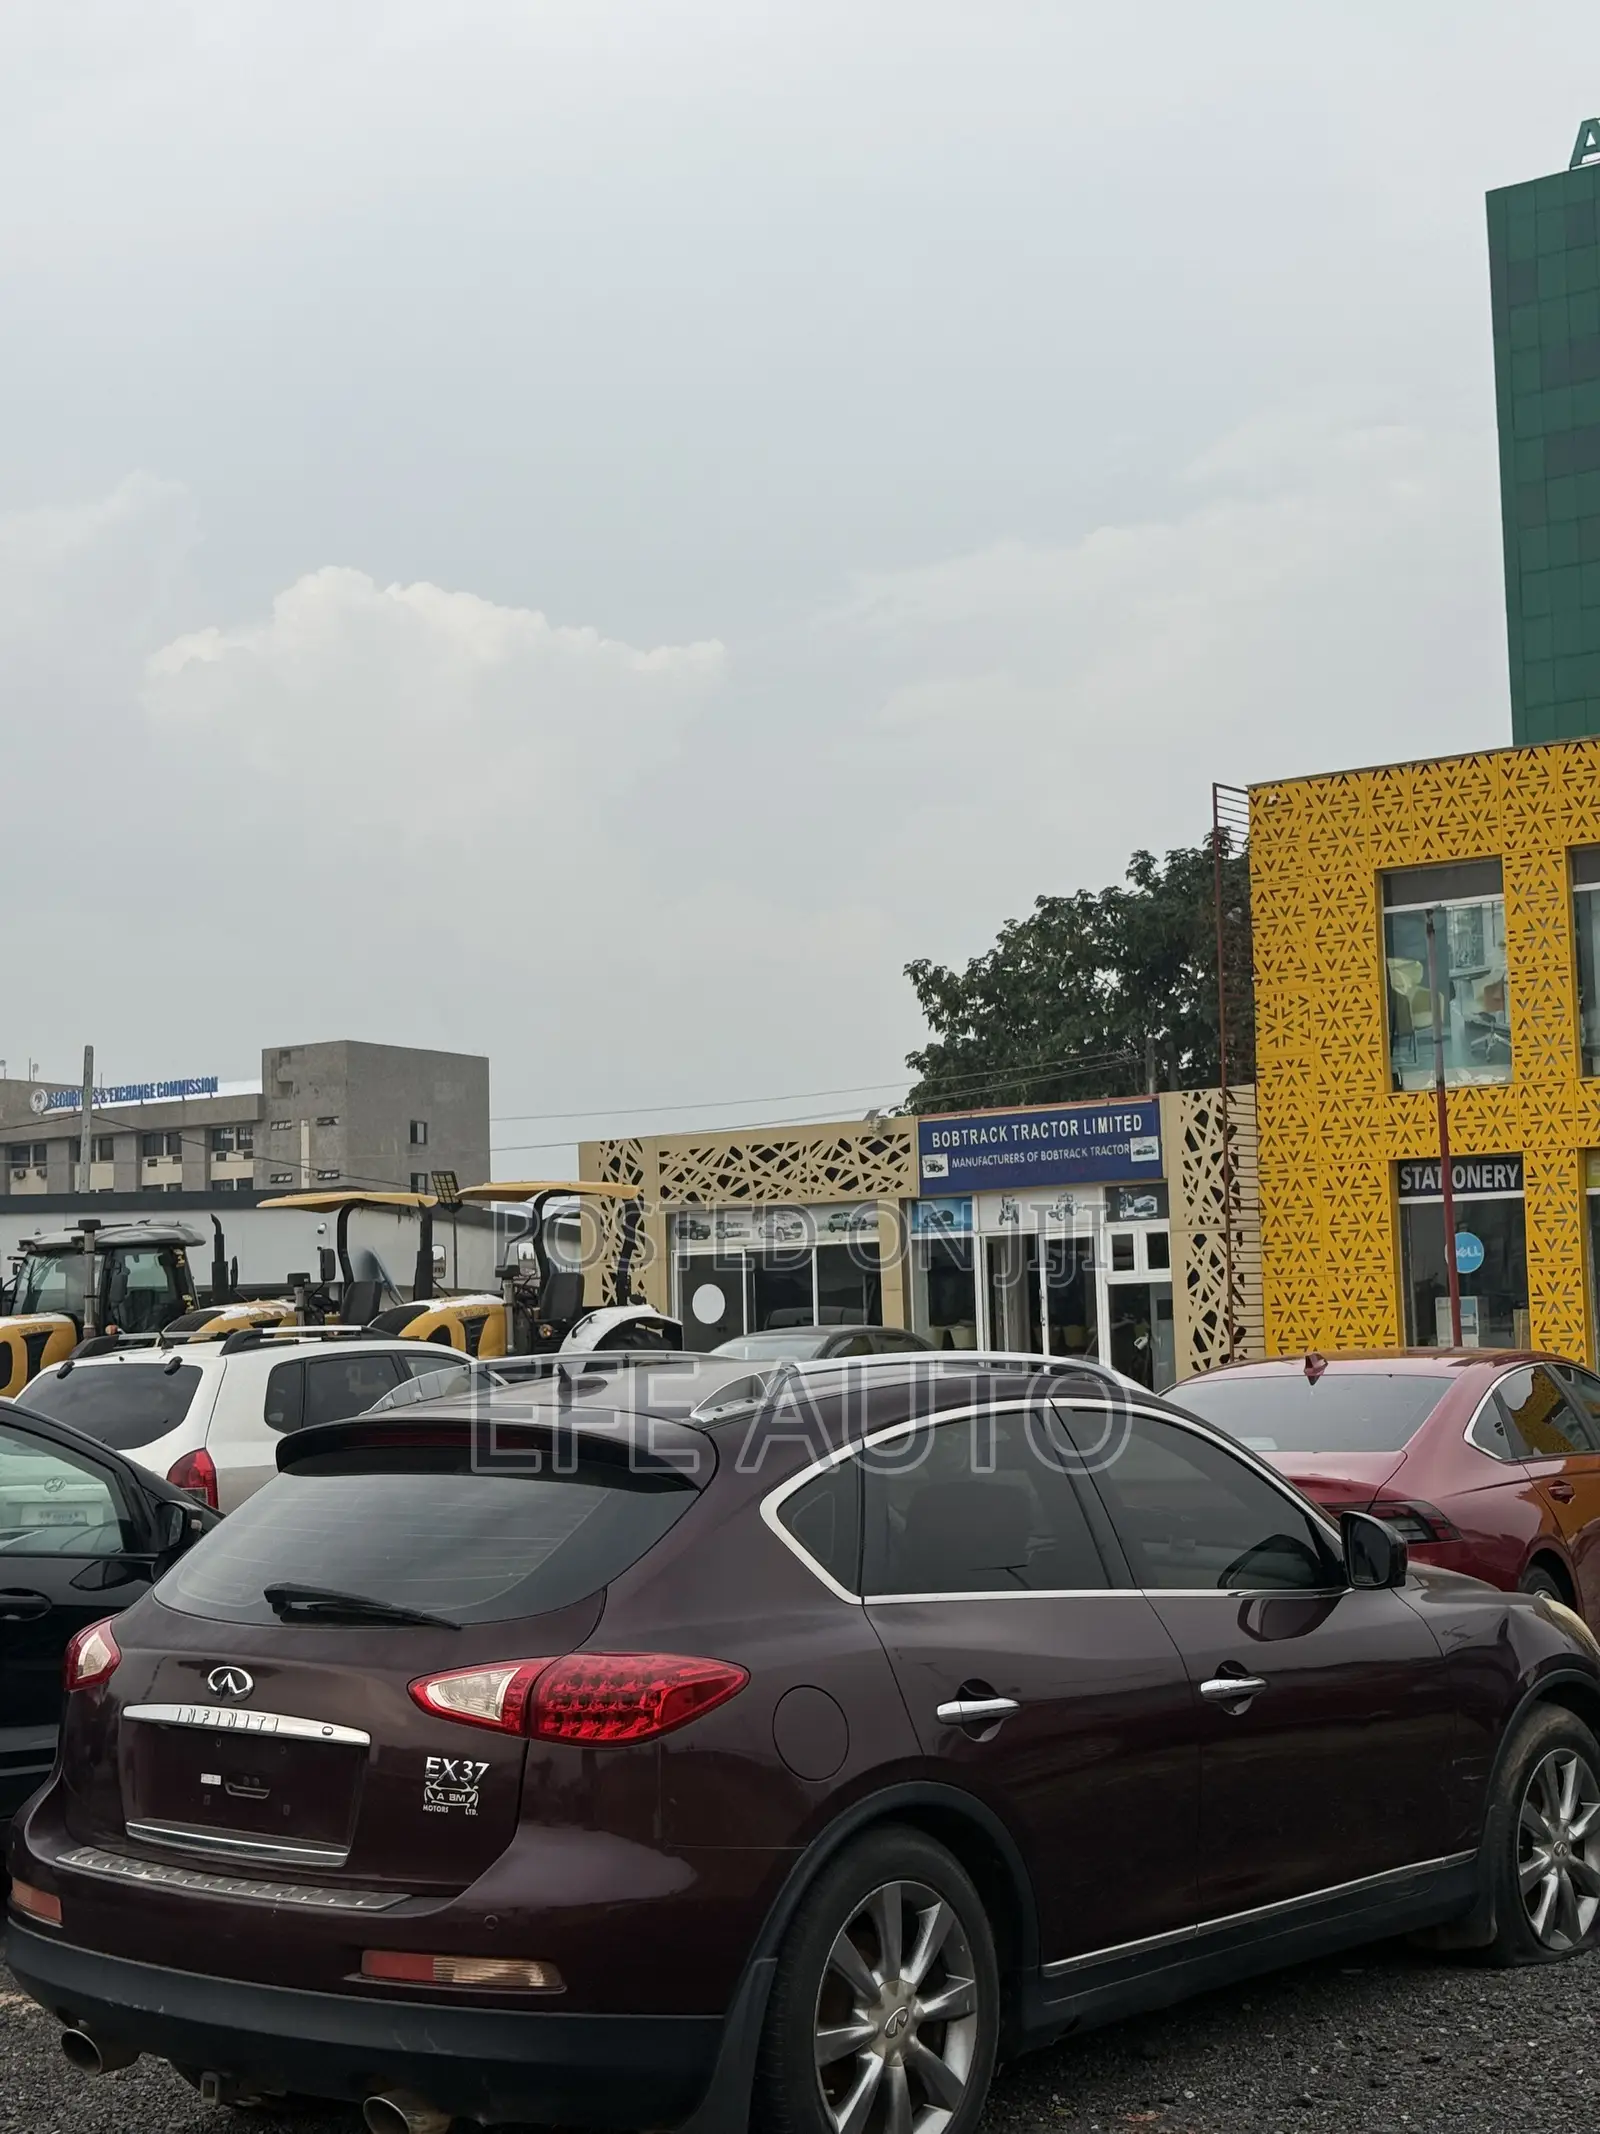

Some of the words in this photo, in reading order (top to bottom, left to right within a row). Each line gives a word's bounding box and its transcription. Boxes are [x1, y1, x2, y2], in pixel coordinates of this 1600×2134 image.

[101, 1089, 108, 1104] &
[109, 1083, 156, 1102] EXCHANGE
[157, 1077, 219, 1098] COMMISSION
[932, 1125, 1008, 1148] BOBTRACK
[1012, 1119, 1079, 1141] TRACTOR
[1083, 1114, 1142, 1136] LIMITED
[951, 1151, 1025, 1169] MANUFACTURERS
[1027, 1150, 1039, 1162] OF
[1040, 1148, 1088, 1161] BOBTRACK
[1090, 1143, 1130, 1156] TRACTOR
[1401, 1164, 1520, 1190] STATONERY
[177, 1708, 280, 1733] INFINITI
[424, 1756, 491, 1784] EX37
[423, 1804, 450, 1814] MOTORS
